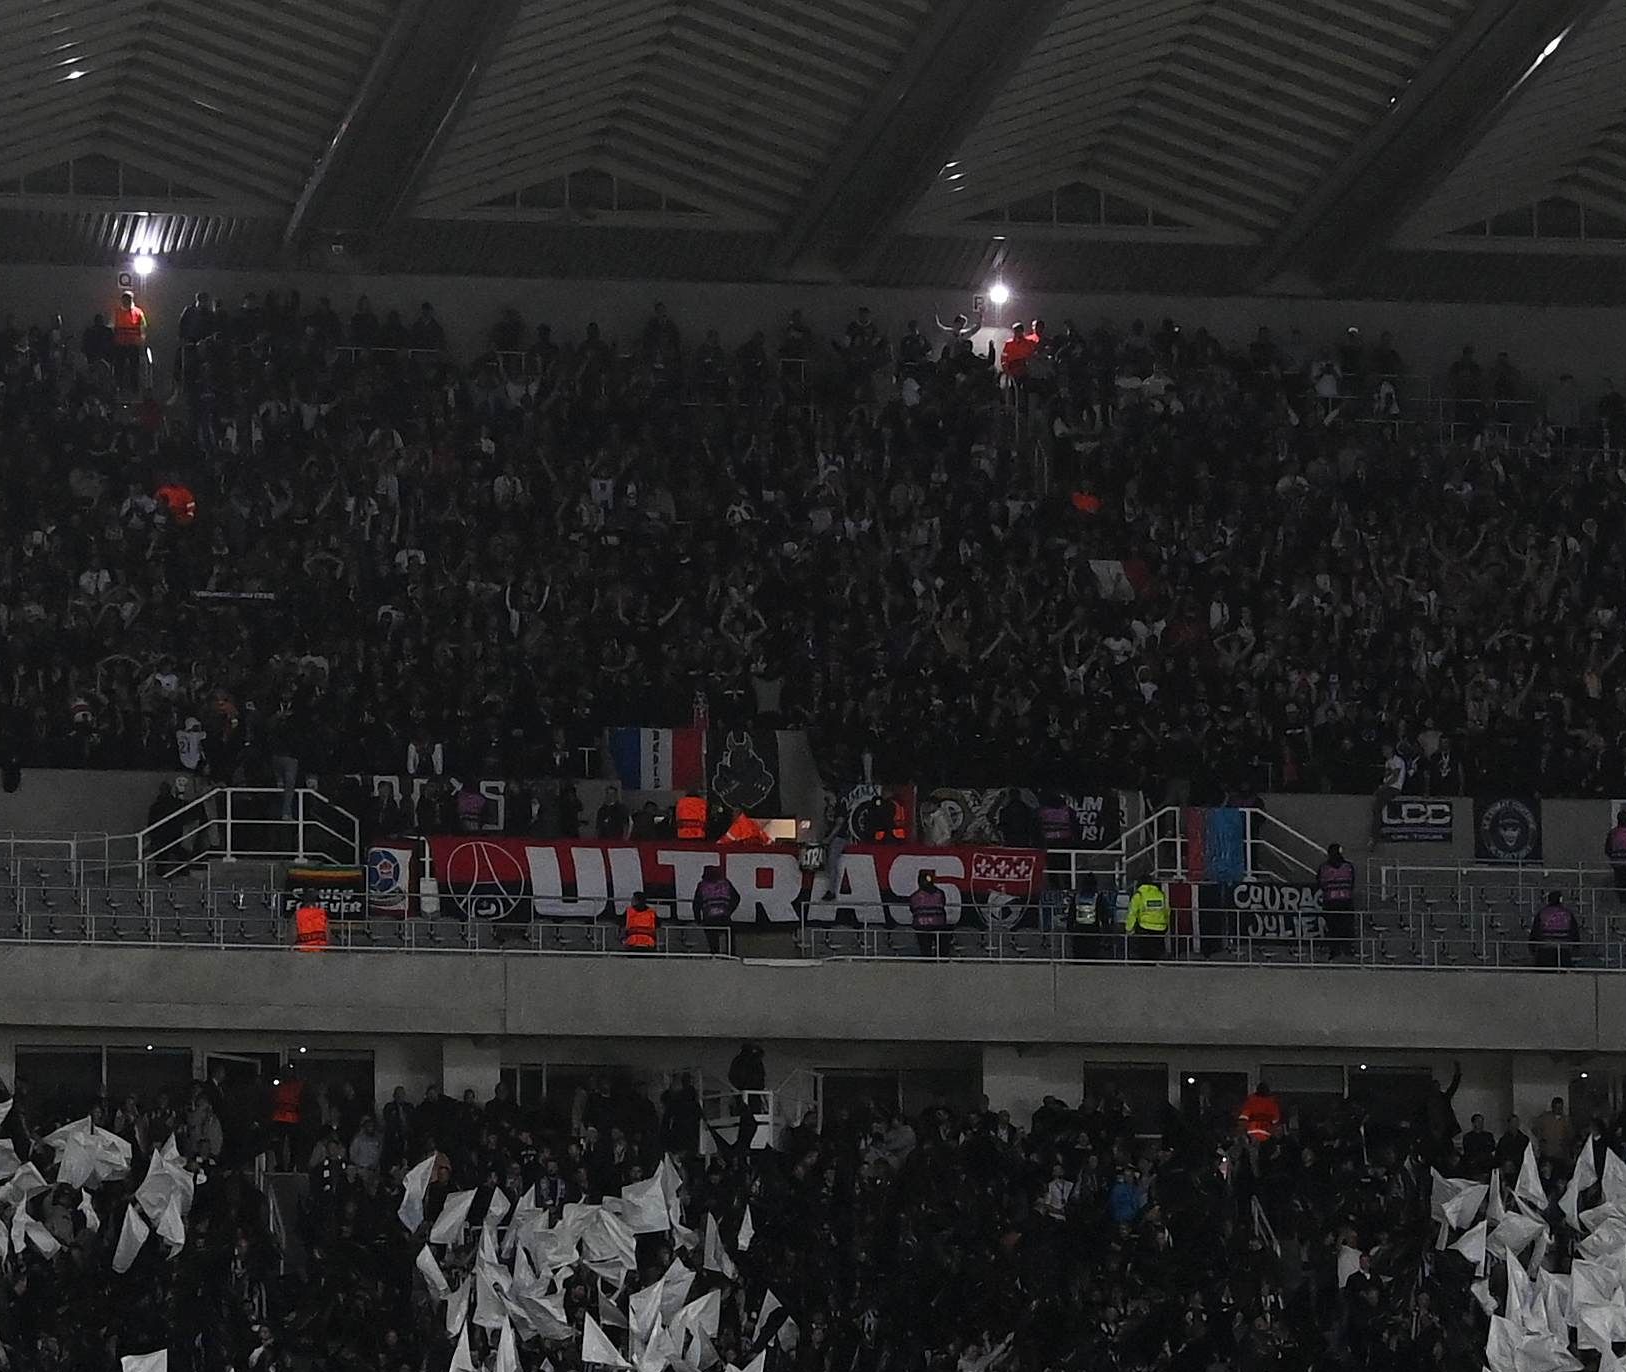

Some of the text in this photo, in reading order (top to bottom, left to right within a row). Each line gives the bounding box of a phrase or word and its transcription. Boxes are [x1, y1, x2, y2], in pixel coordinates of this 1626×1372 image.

[119, 273, 132, 286] Q
[526, 845, 963, 926] ULTRAS
[286, 900, 362, 913] FOEVER
